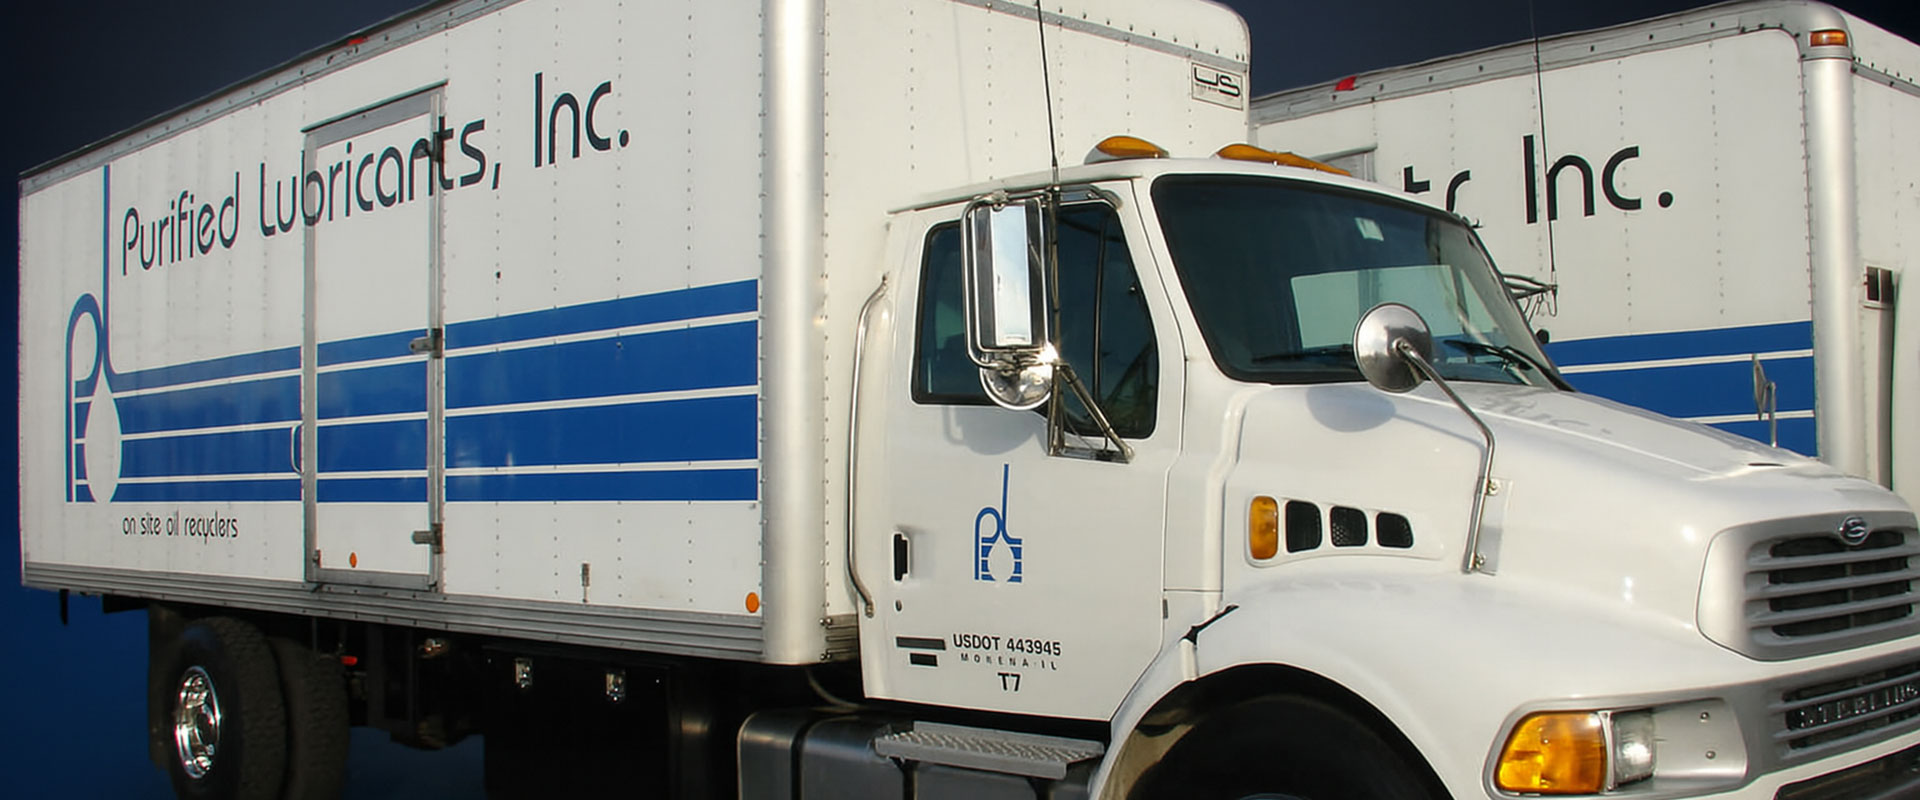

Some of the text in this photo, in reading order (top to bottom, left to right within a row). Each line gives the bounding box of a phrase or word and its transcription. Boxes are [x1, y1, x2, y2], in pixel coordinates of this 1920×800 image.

[1194, 67, 1240, 97] US
[122, 72, 629, 276] Purified Lubricants, Inc.
[1522, 134, 1673, 224] Inc.
[123, 510, 239, 545] on site oil recyclers
[953, 634, 1061, 656] USDOT 443945
[997, 672, 1020, 692] T7
